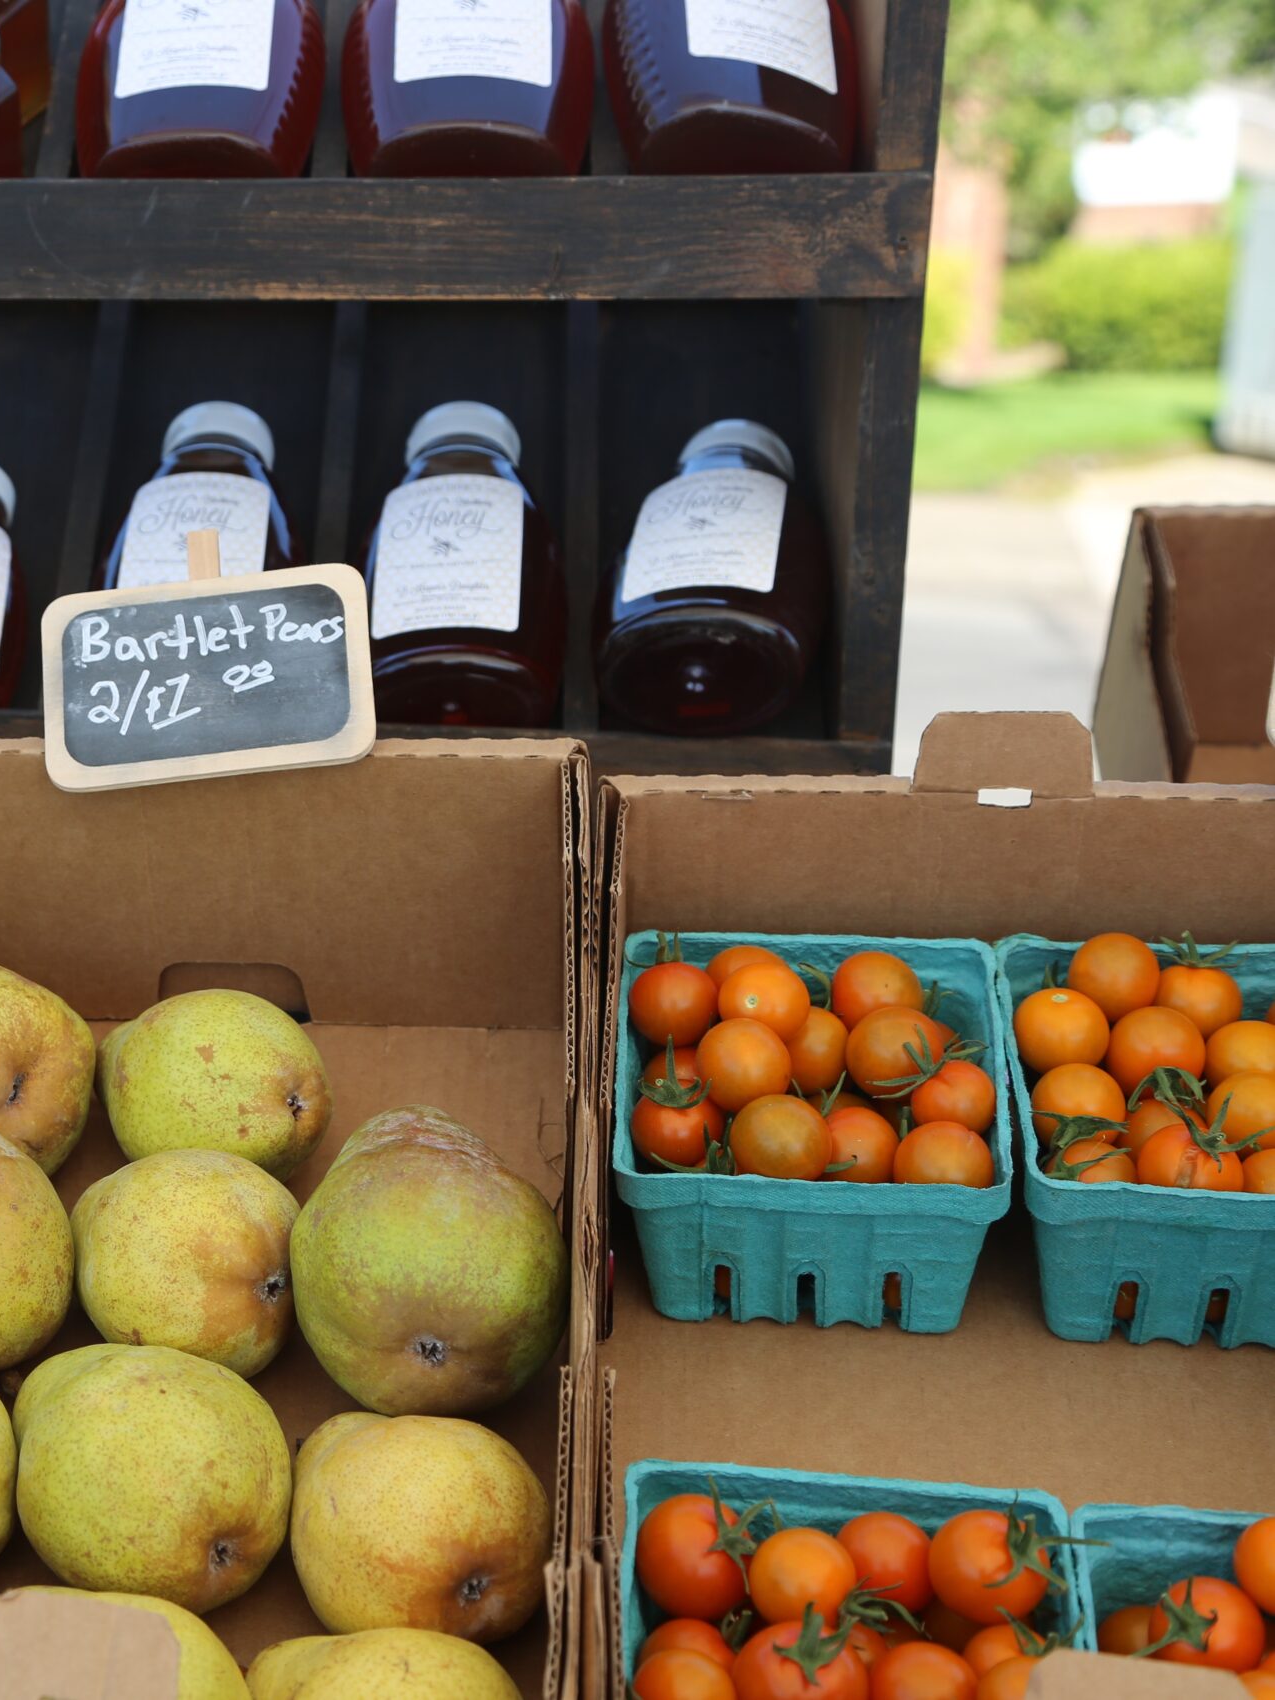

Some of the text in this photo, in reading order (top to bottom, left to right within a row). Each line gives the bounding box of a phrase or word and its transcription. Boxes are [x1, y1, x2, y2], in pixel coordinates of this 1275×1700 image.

[138, 494, 248, 534] Honey
[391, 497, 503, 540] Honey
[80, 604, 255, 663] Bartlet
[259, 603, 345, 644] Pears
